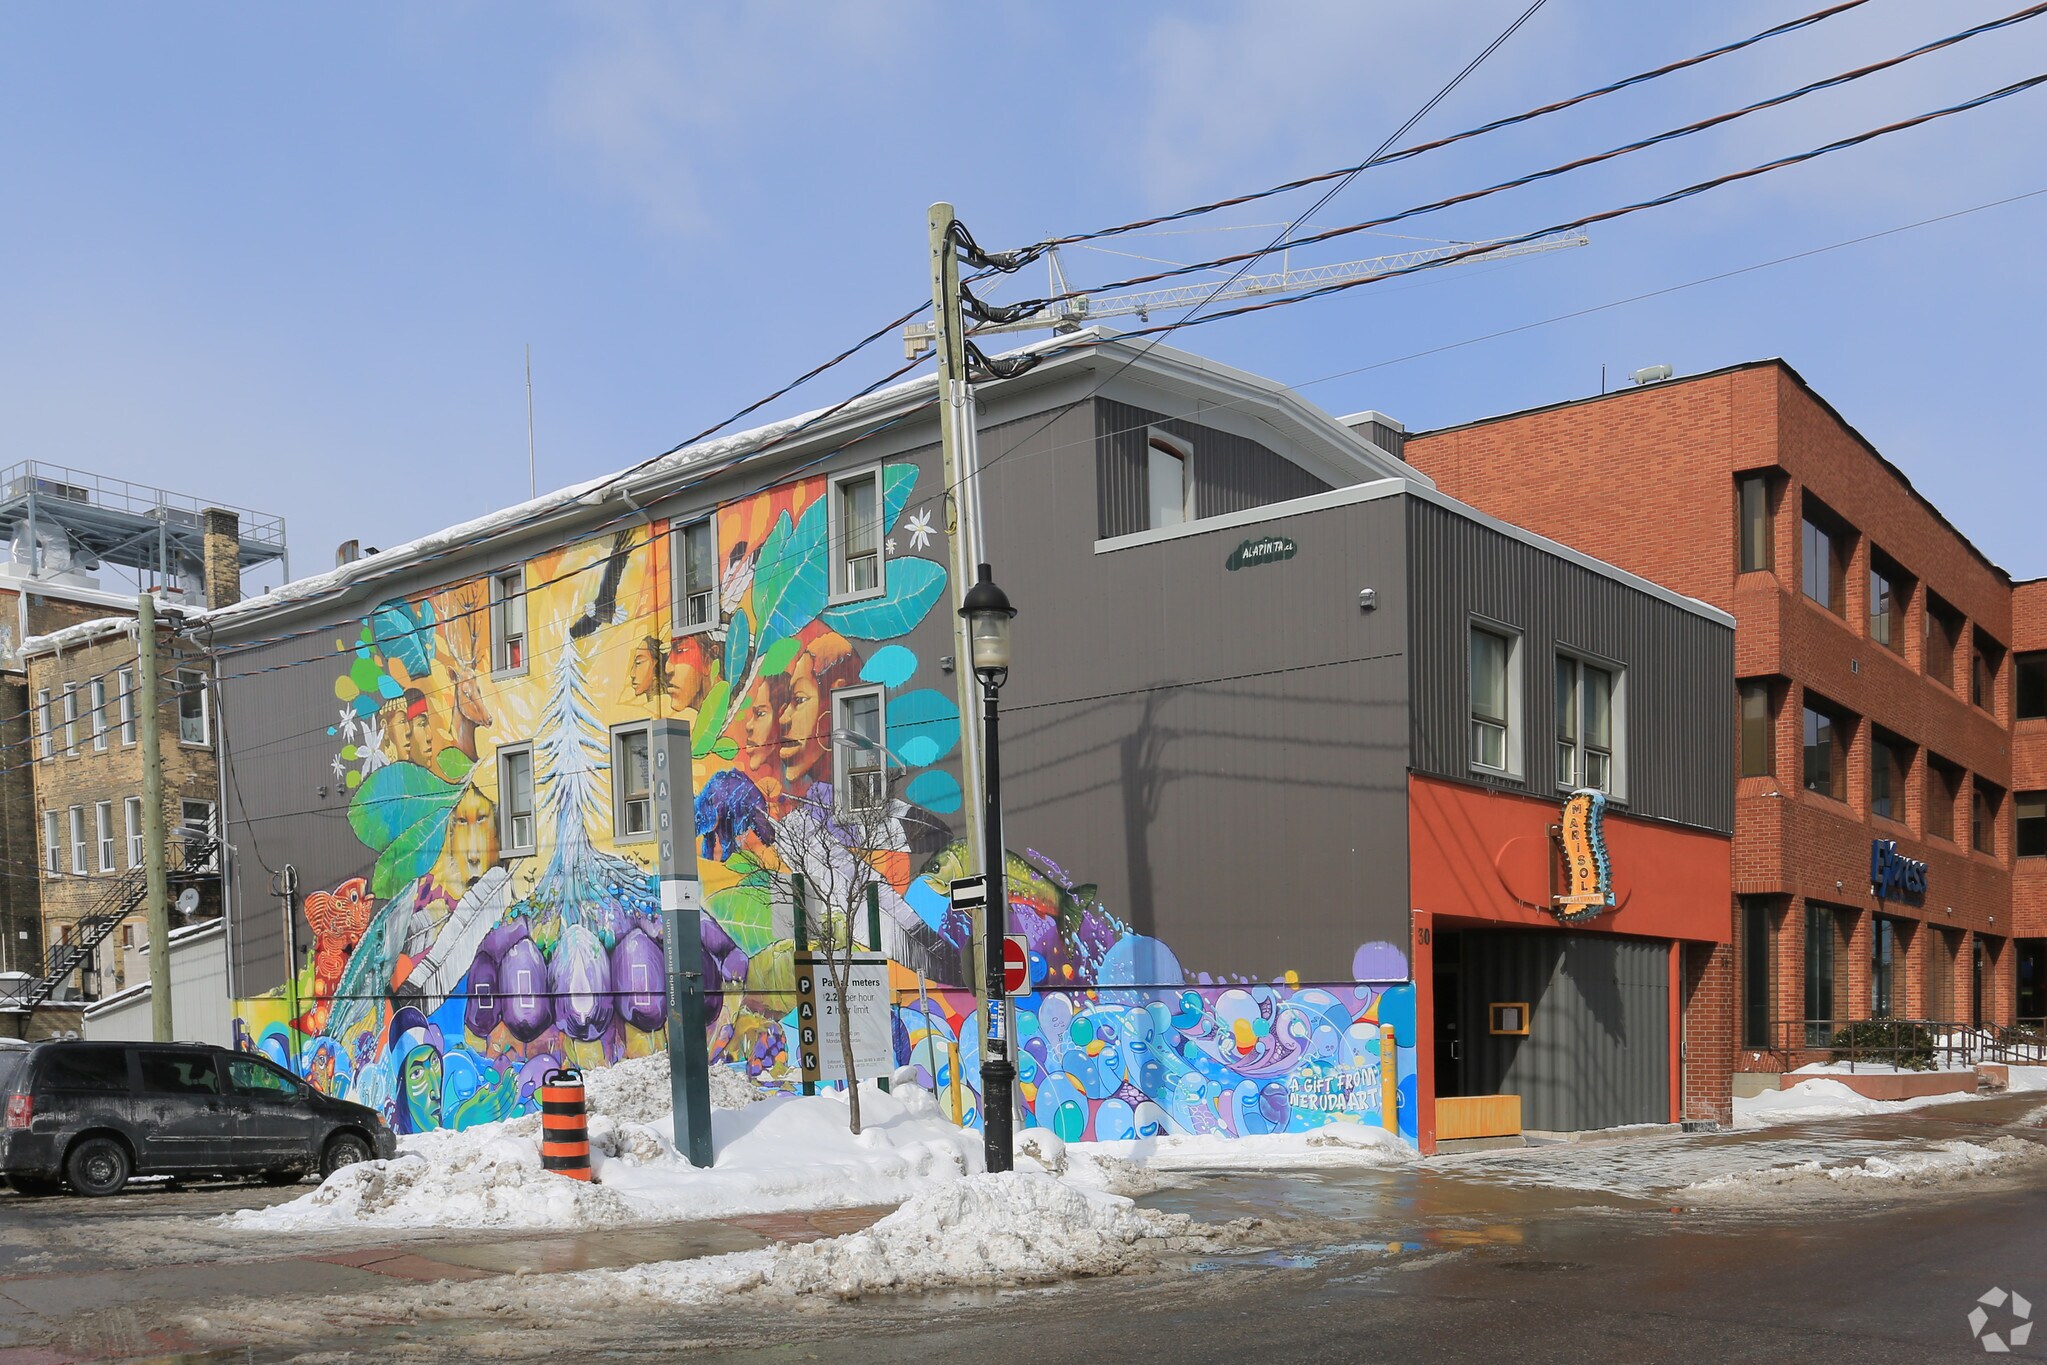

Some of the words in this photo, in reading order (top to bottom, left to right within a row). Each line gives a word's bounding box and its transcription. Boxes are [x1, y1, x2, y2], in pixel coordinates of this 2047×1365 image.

[657, 752, 671, 858] PARK
[1418, 928, 1431, 945] 30
[668, 975, 676, 1006] Ontario
[852, 979, 881, 987] meters
[823, 992, 838, 1002] $2.2
[858, 993, 875, 1002] hour
[826, 1006, 833, 1015] 2
[854, 1005, 869, 1014] limit
[801, 980, 815, 1068] PARK
[1289, 1078, 1300, 1093] A
[1337, 1068, 1378, 1092] FROM
